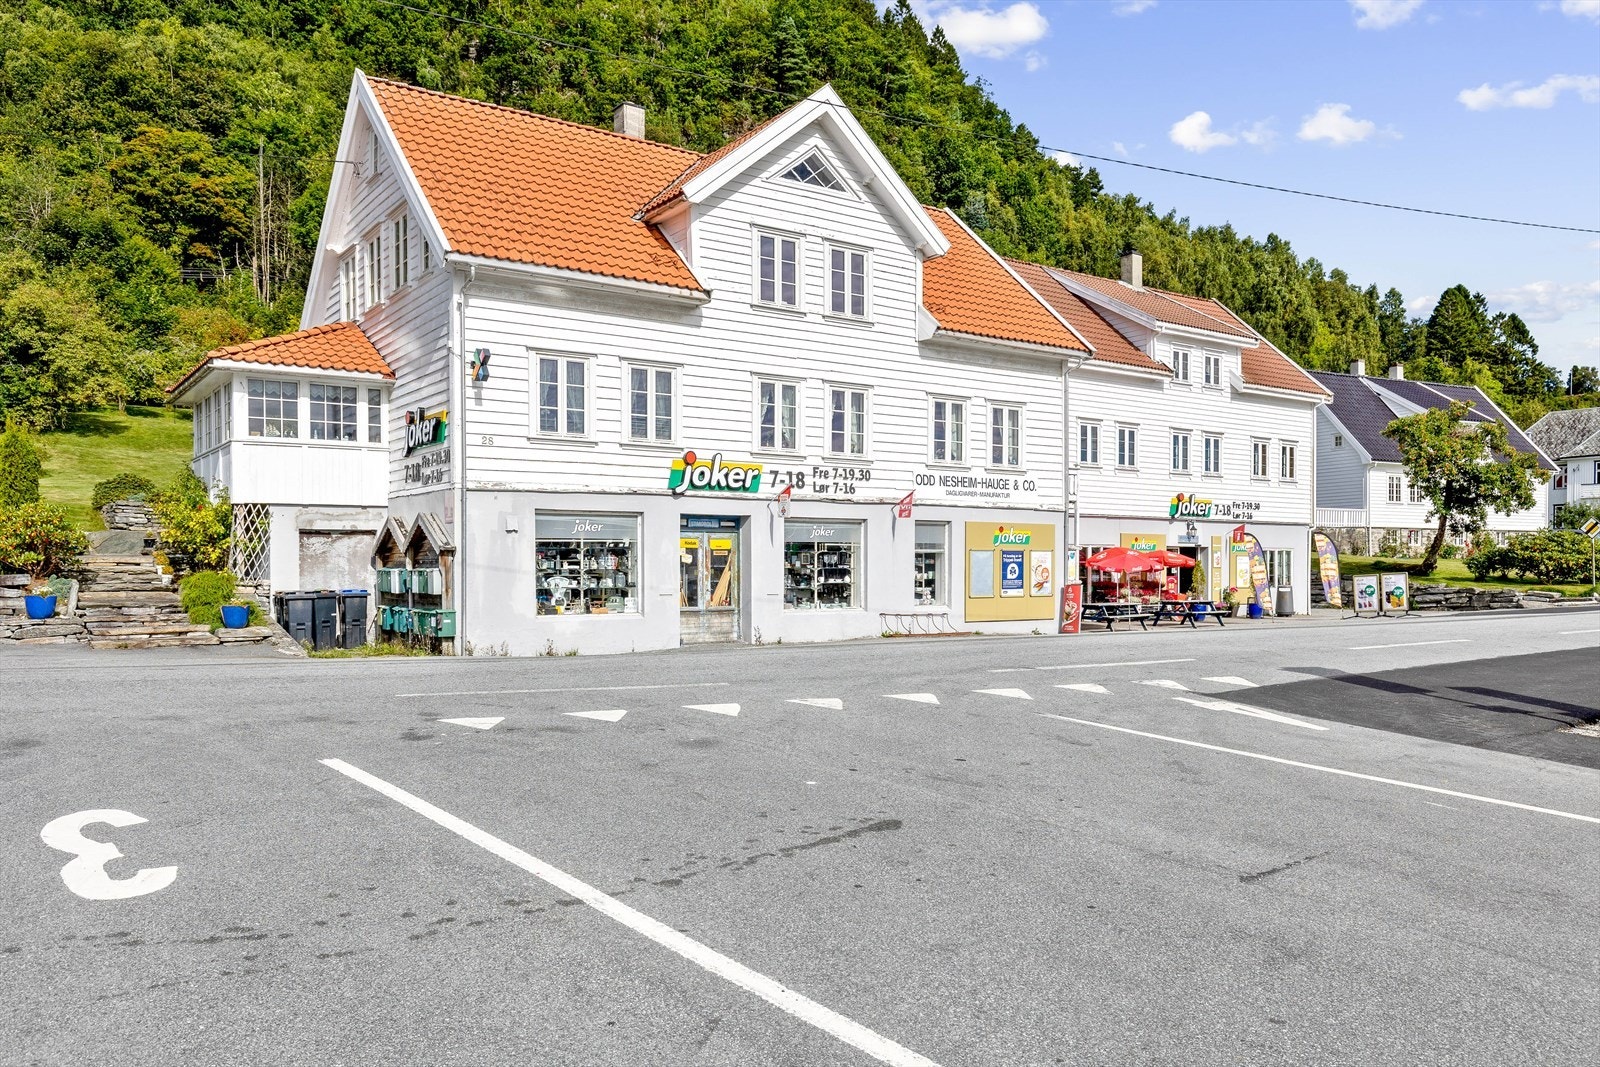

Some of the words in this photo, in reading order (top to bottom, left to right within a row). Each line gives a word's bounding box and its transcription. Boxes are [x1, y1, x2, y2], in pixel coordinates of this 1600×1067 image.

[402, 407, 439, 458] joker
[481, 435, 494, 446] 28
[674, 450, 761, 495] joker
[769, 470, 806, 490] 7-18
[812, 466, 829, 480] Fre
[832, 467, 871, 482] 7-19.30
[812, 481, 830, 494] Lør
[832, 482, 856, 495] 7-16
[915, 473, 936, 487] ODD
[939, 475, 1010, 491] NESHEIM-HAUGE
[1013, 479, 1020, 491] &
[1022, 480, 1037, 492] CO.
[1174, 492, 1212, 519] joker
[1214, 504, 1231, 516] 7-18
[571, 519, 604, 534] joker
[810, 525, 835, 539] joker
[994, 525, 1029, 548] joker
[1132, 536, 1156, 551] joker
[40, 808, 178, 900] 3
